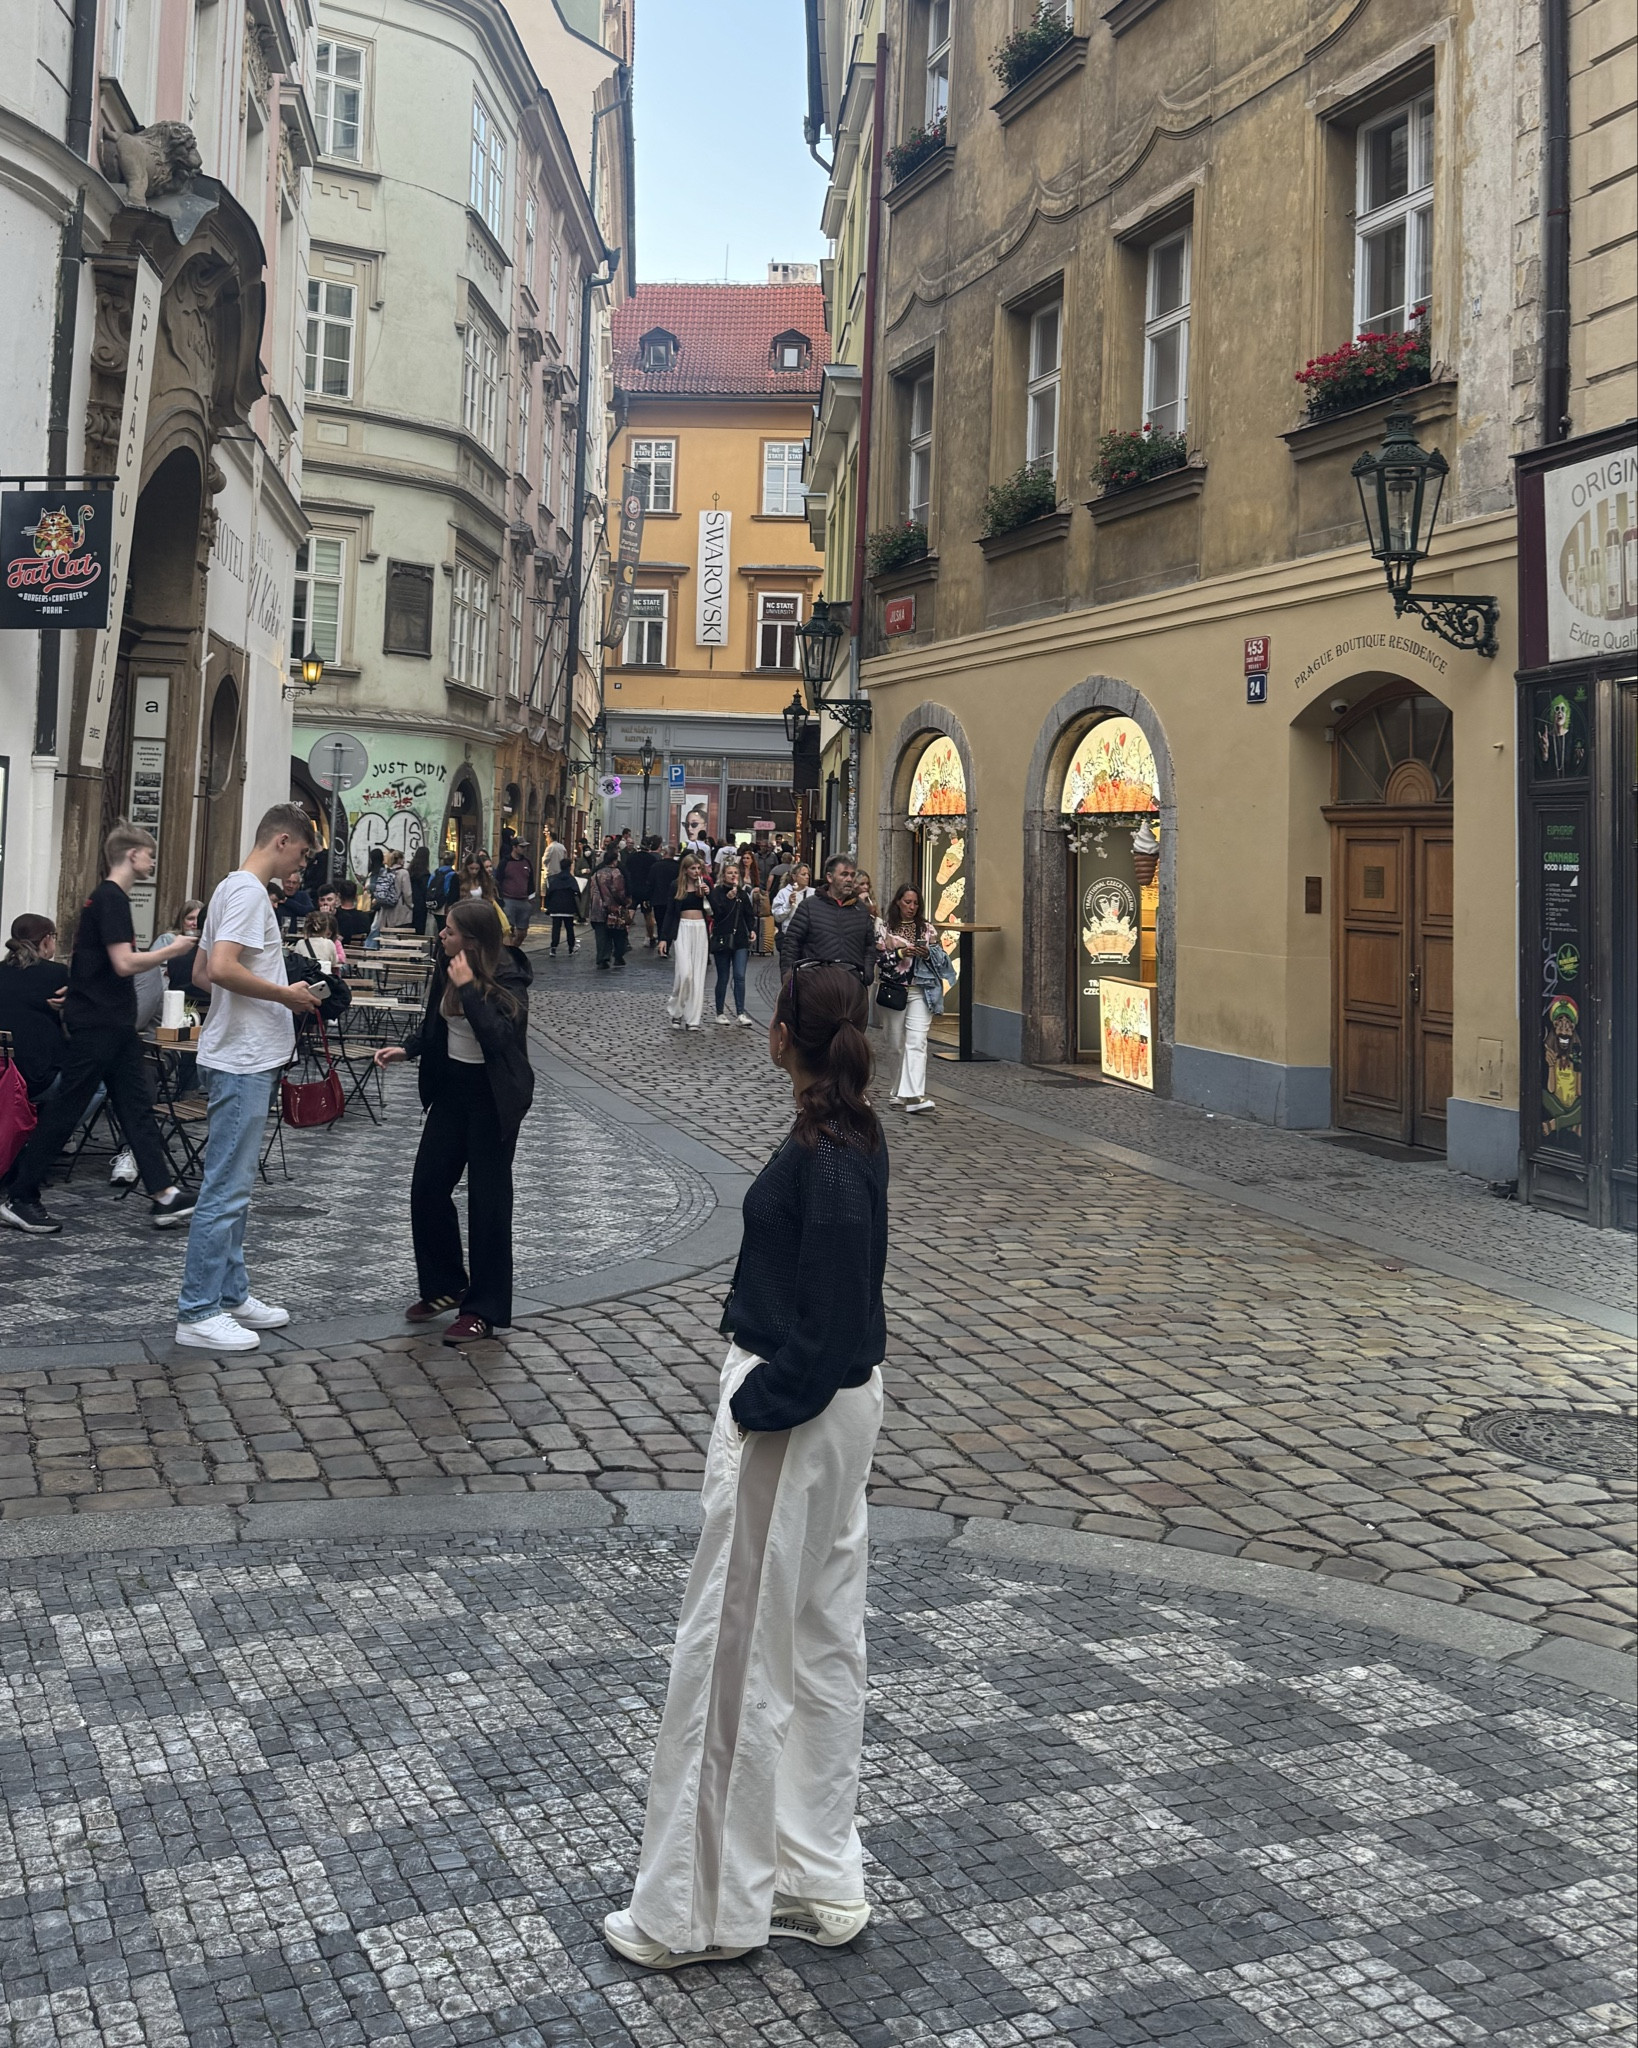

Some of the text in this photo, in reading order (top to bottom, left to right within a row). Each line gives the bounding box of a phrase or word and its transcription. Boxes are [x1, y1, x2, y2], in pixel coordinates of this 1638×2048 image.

[7, 552, 93, 589] Fat Cat
[702, 512, 725, 644] SWAROVSKI
[23, 592, 49, 602] BURGERS
[776, 602, 795, 610] STATE
[1569, 622, 1600, 648] Extra
[1247, 639, 1264, 656] 453
[1294, 634, 1449, 689] PRAGUE BOUTIQUE RESIDENCE
[1250, 681, 1261, 697] 24
[372, 761, 408, 778] JUST
[671, 767, 682, 781] P
[1543, 851, 1580, 864] CANNABIS
[1543, 863, 1559, 871] FOOD
